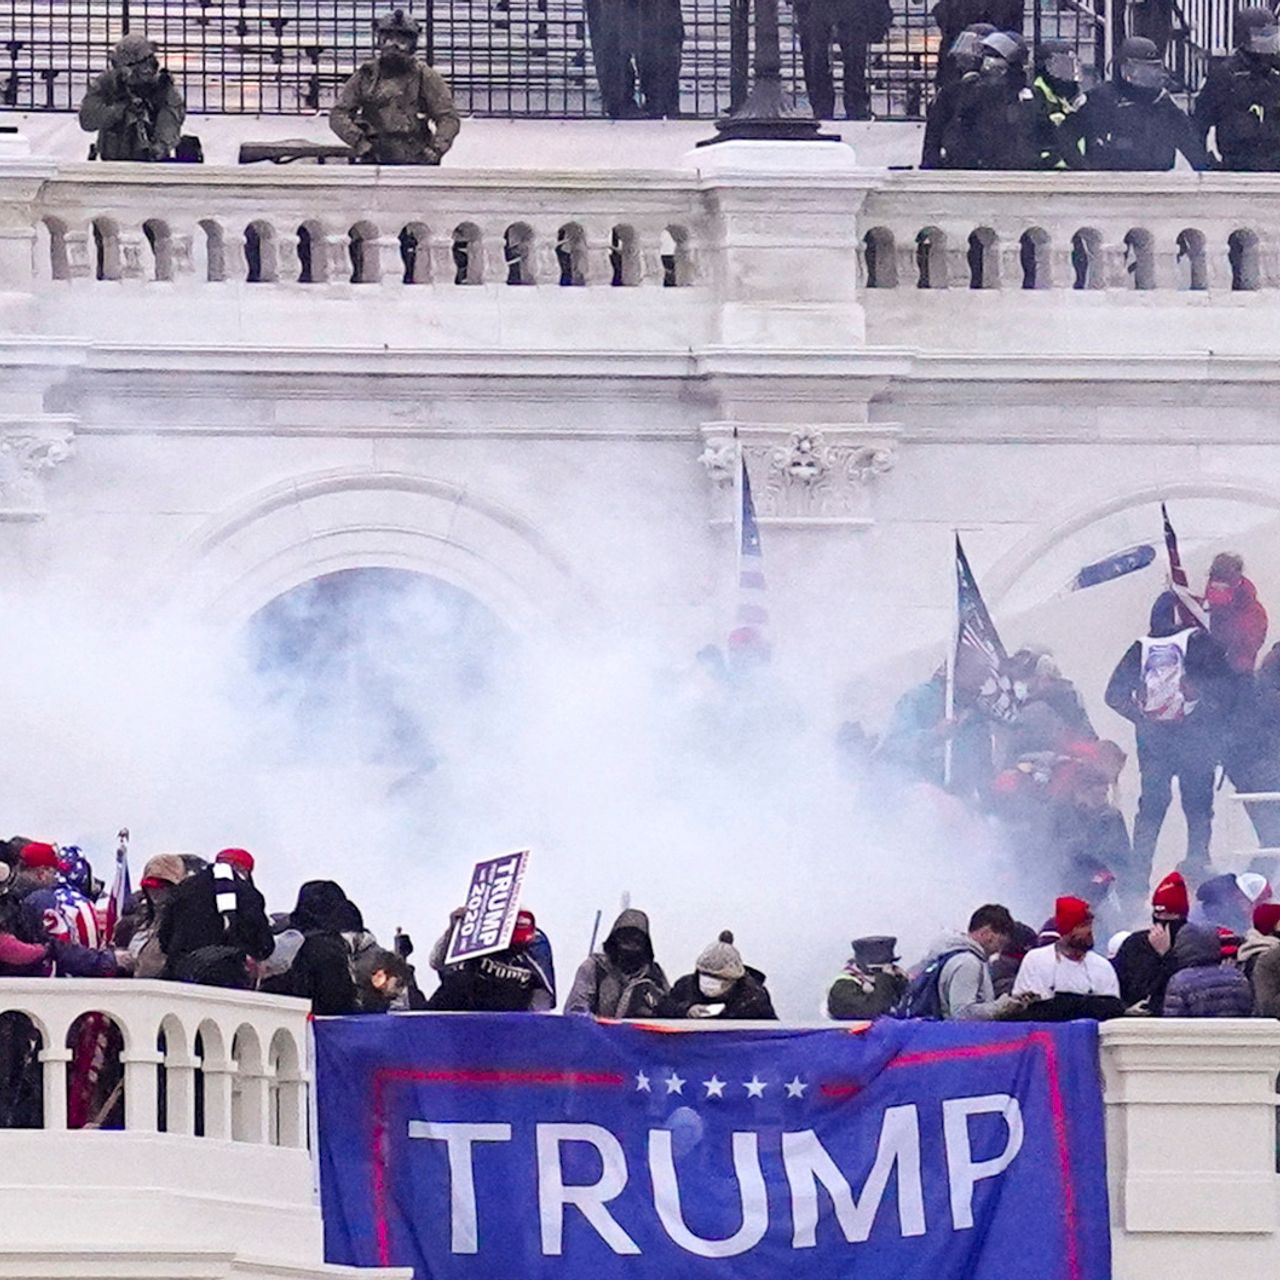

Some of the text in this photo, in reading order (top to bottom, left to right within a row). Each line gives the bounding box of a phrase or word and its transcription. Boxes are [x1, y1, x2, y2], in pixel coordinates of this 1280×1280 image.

[460, 881, 486, 938] 2020
[478, 857, 518, 946] TRUMP
[407, 1093, 1025, 1259] TRUMP
